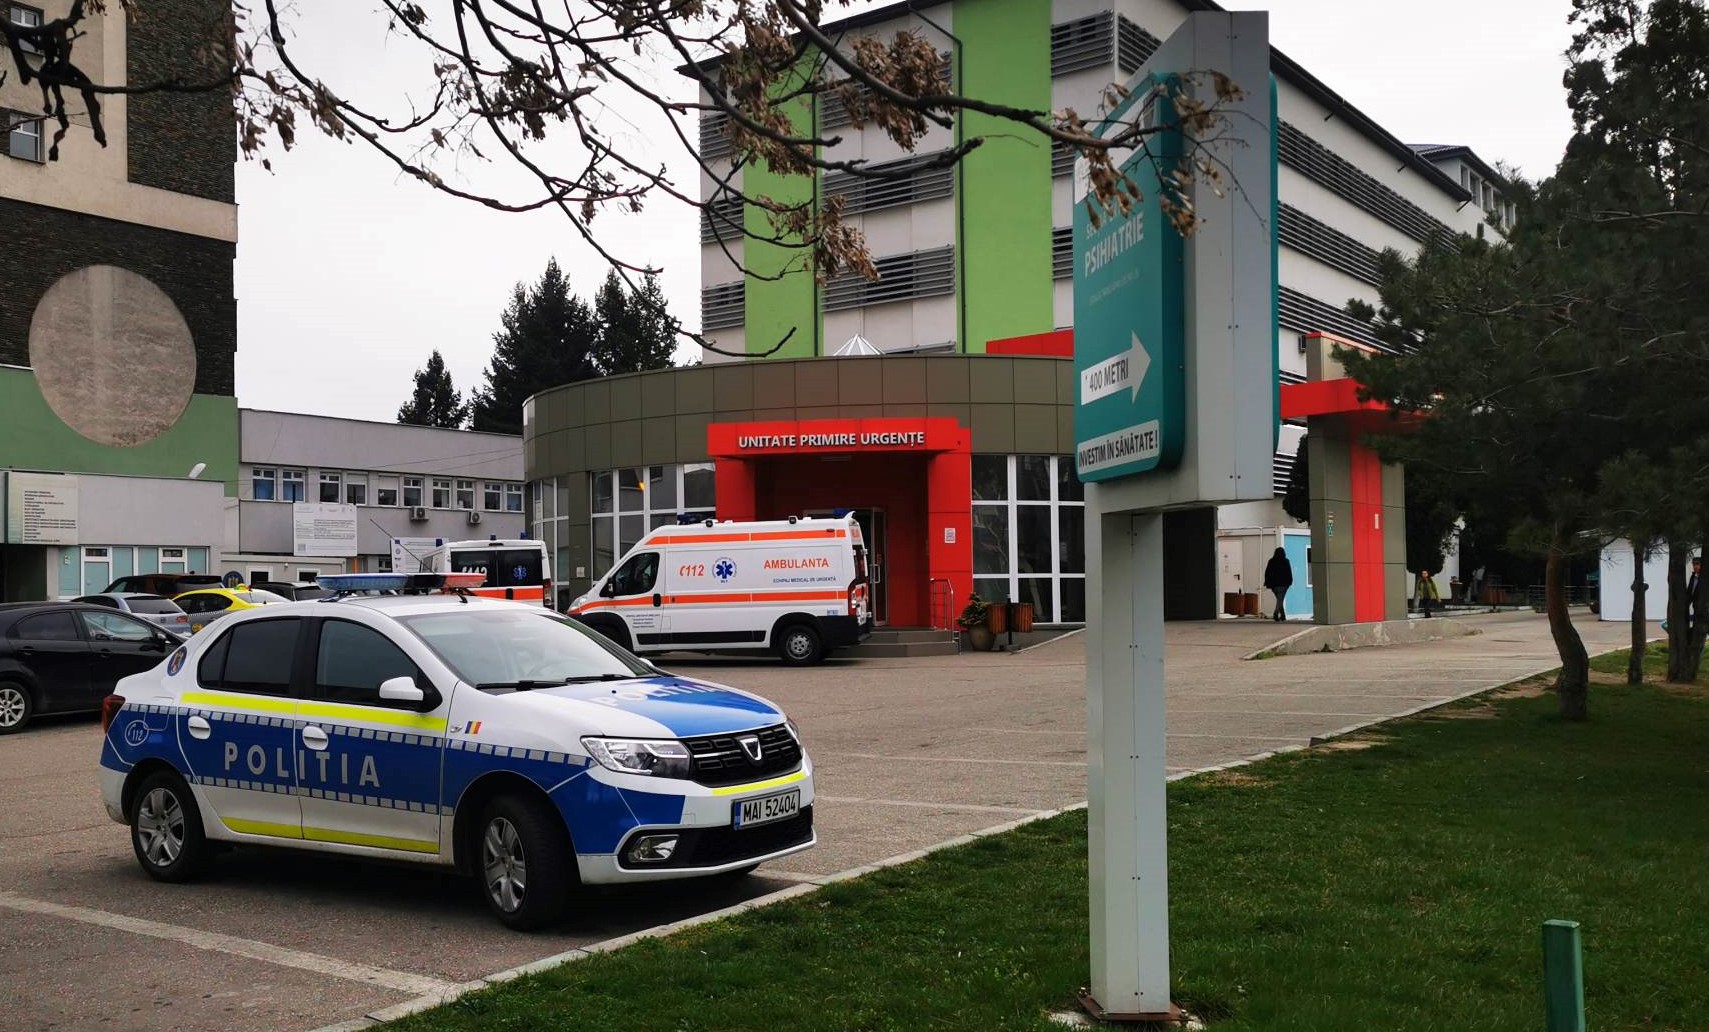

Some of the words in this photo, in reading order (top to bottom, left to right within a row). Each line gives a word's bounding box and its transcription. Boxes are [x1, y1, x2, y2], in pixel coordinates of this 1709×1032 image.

[1084, 211, 1145, 279] PSIHIATRIE
[1089, 369, 1103, 393] 400
[1104, 357, 1129, 388] METRI
[739, 435, 797, 448] UNITATE
[800, 433, 857, 447] PRIMIRE
[1079, 444, 1107, 467] INVESTIM
[1107, 439, 1115, 461] ÎN
[686, 564, 705, 577] 112
[224, 741, 381, 788] POLITIA
[743, 801, 762, 823] MAI
[765, 794, 796, 818] 52404
